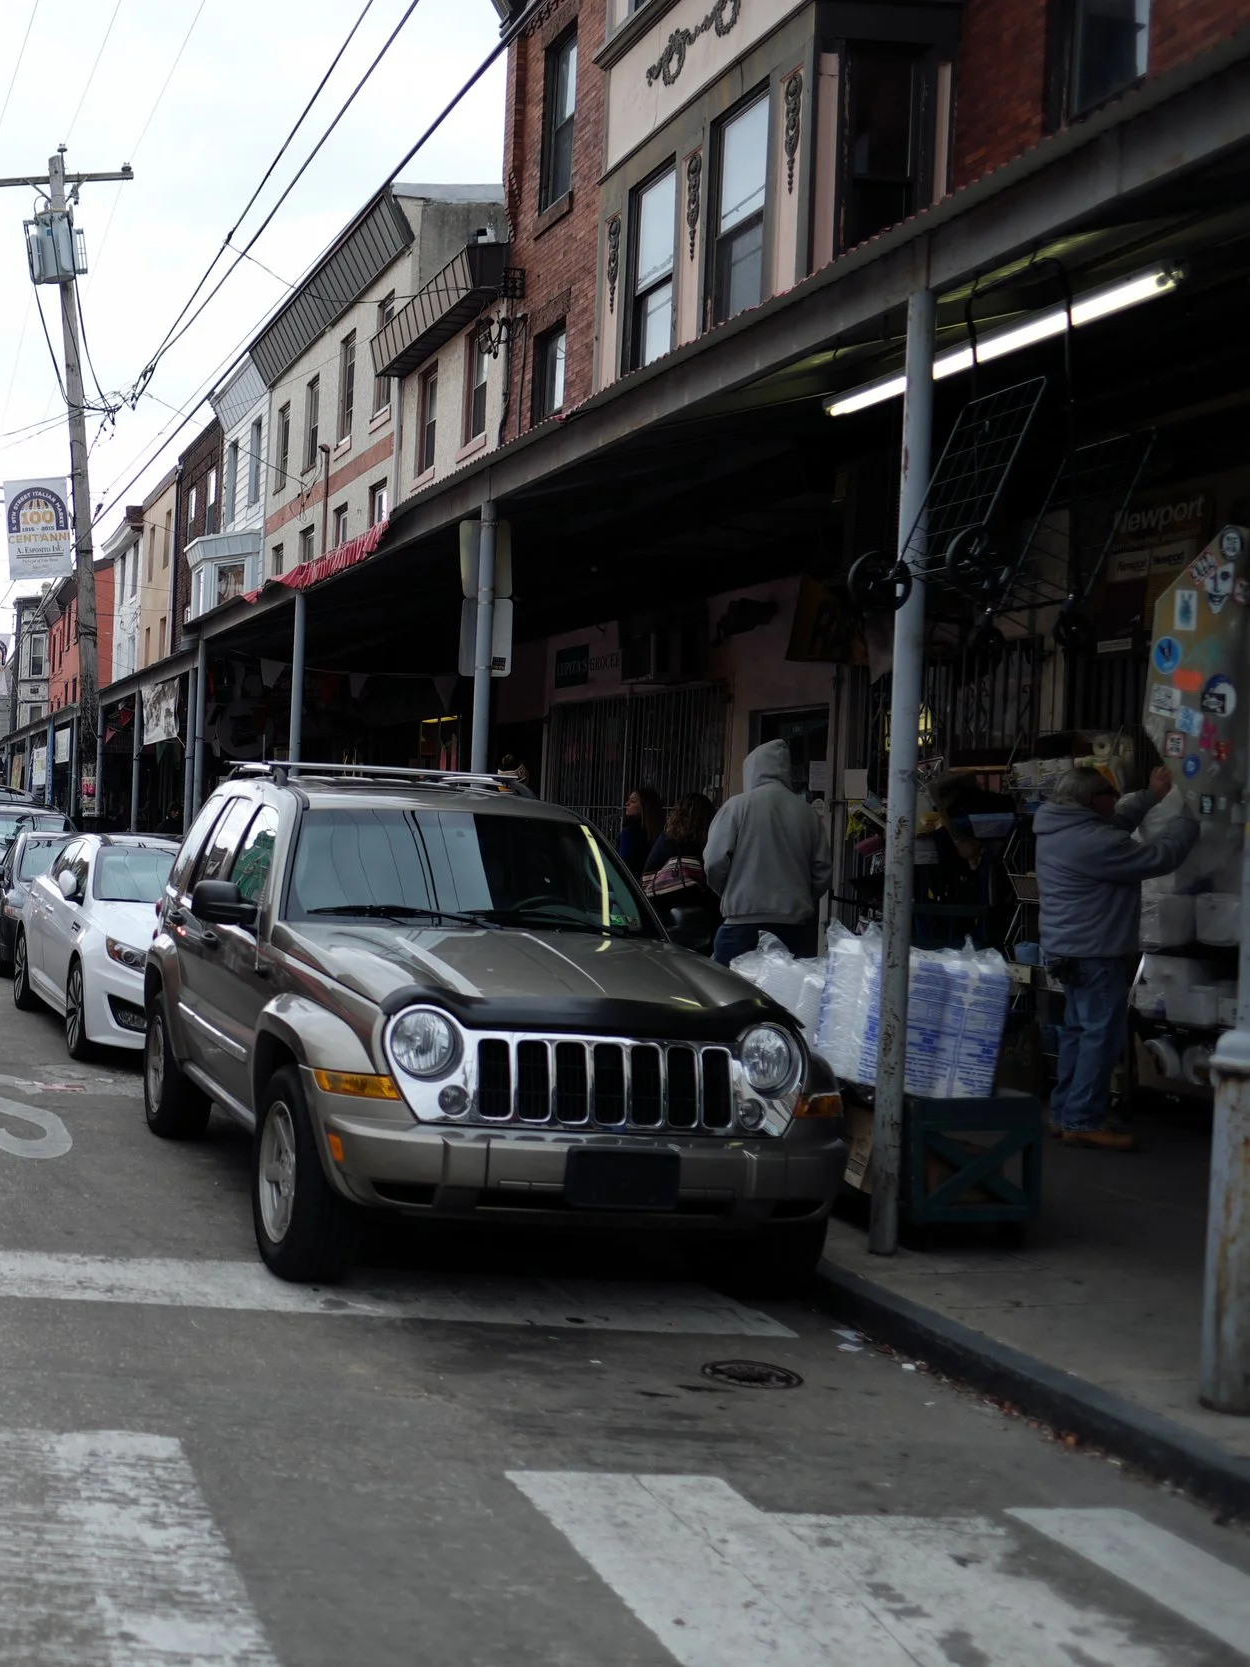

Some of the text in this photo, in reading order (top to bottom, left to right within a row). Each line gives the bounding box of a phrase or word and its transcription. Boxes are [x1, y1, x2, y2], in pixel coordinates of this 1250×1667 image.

[13, 492, 31, 511] STREET
[32, 490, 57, 503] ITALIAN
[55, 502, 65, 528] MARKET
[21, 510, 55, 526] 100
[1113, 494, 1205, 533] Newport
[8, 532, 70, 544] CENT'ANNI
